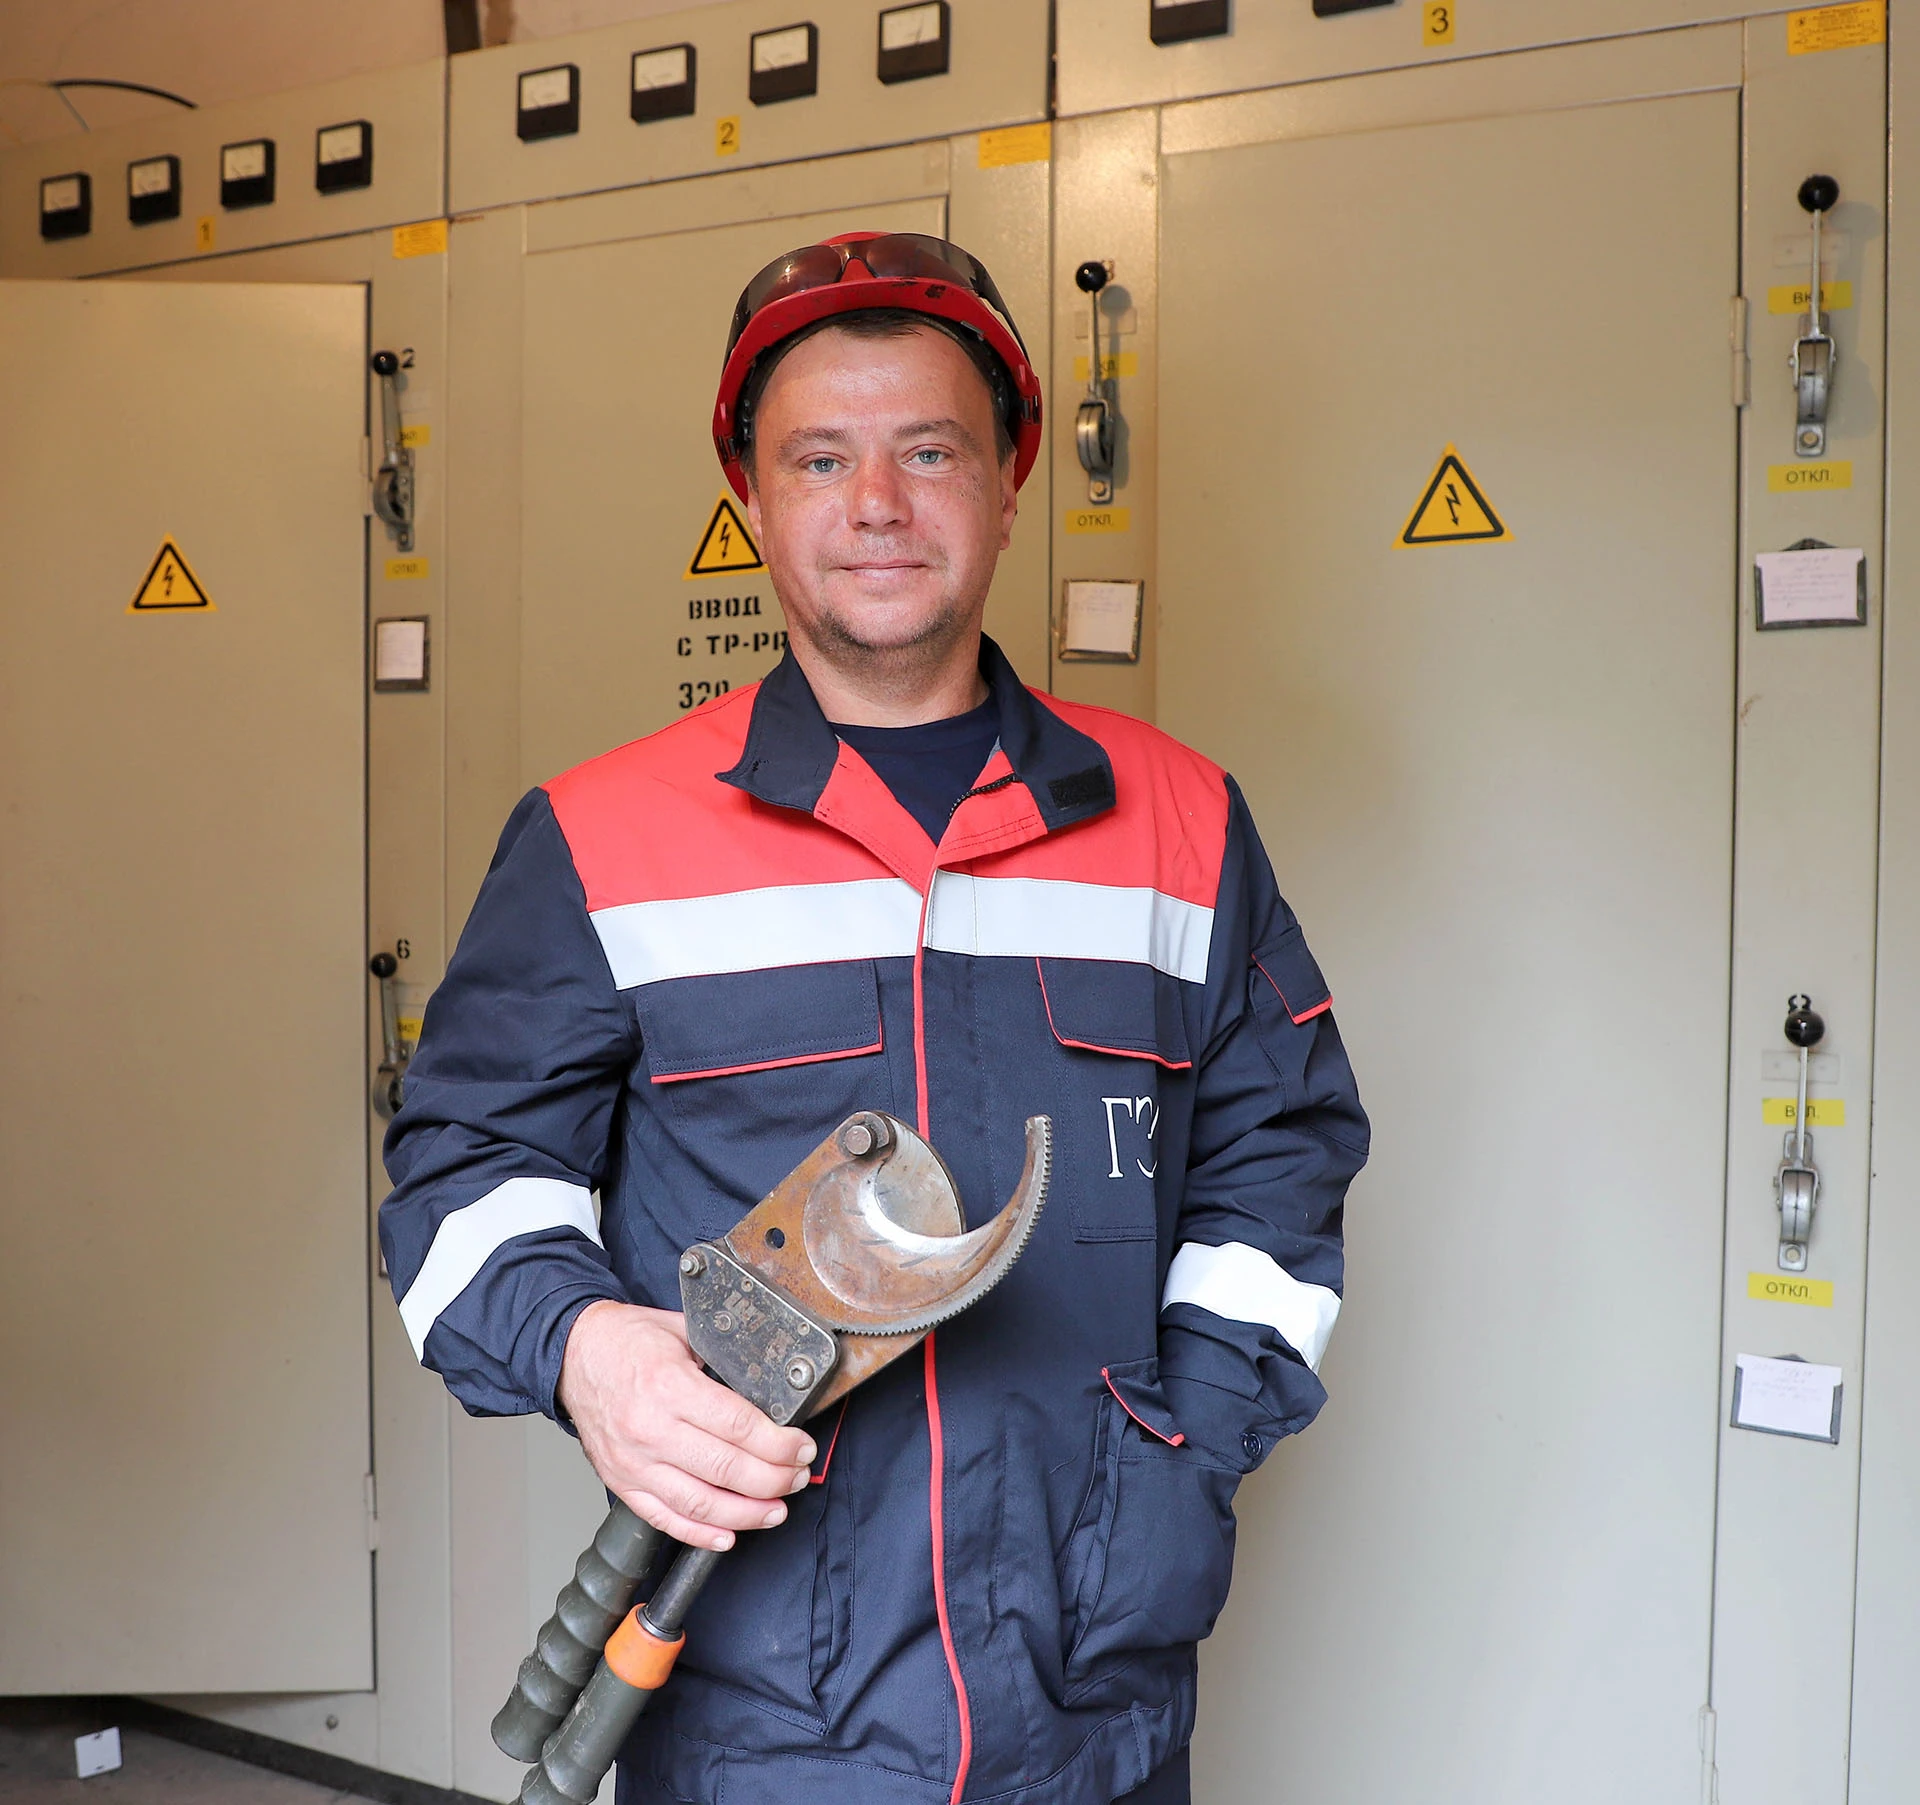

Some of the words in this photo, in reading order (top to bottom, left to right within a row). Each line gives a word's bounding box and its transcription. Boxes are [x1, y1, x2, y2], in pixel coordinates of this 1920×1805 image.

[1431, 6, 1449, 35] 3
[719, 122, 735, 146] 2
[200, 222, 210, 242] 1
[401, 346, 416, 368] 2
[688, 595, 762, 620] ВВОД
[677, 636, 693, 657] С
[396, 938, 411, 960] 6
[1784, 1104, 1821, 1119] ВЛ.
[1766, 1281, 1813, 1300] ОТКЛ.
